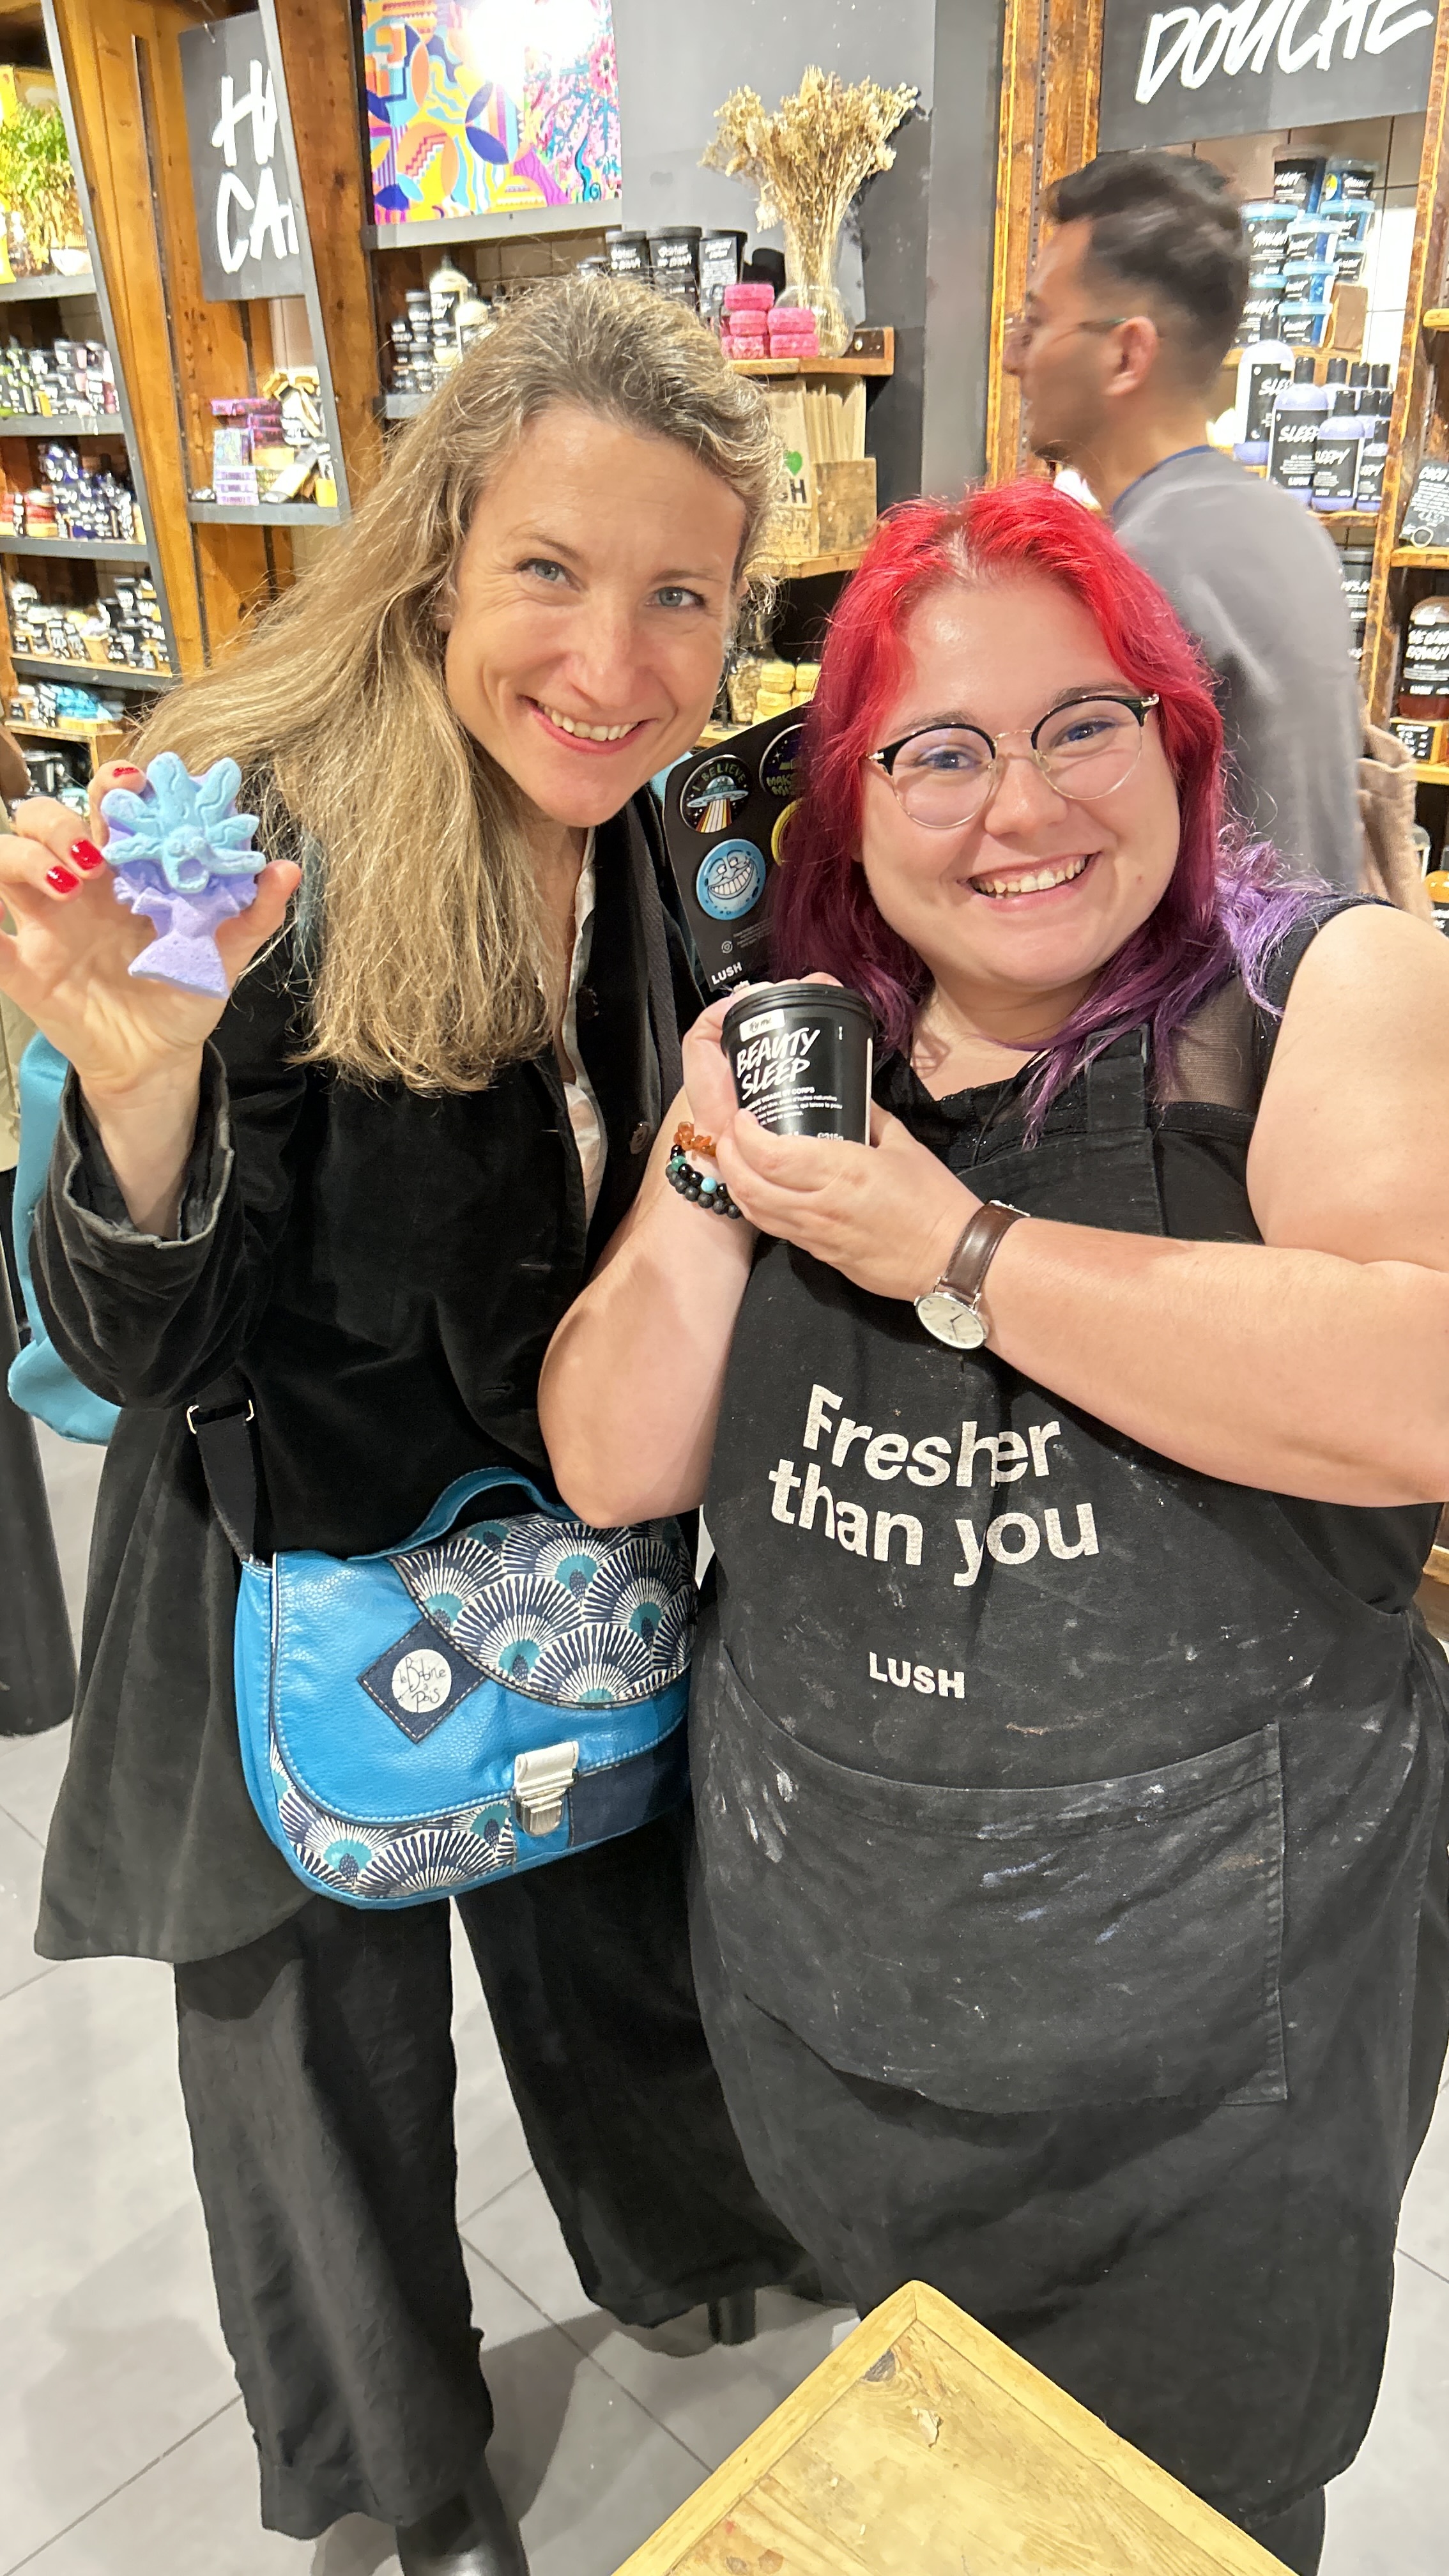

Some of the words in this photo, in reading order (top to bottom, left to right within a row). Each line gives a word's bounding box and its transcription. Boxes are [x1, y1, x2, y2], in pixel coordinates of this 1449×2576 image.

[1135, 0, 1434, 105] DOUCHE
[702, 763, 746, 784] BELIEVE
[711, 962, 742, 985] LUSH
[736, 1027, 821, 1078] BEAUTY
[742, 1057, 811, 1101] SLEEP
[792, 1087, 815, 1095] CORPS
[802, 1384, 1061, 1487] Fresher
[768, 1459, 924, 1566] than
[953, 1503, 1100, 1587] you
[869, 1652, 965, 1699] LUSH
